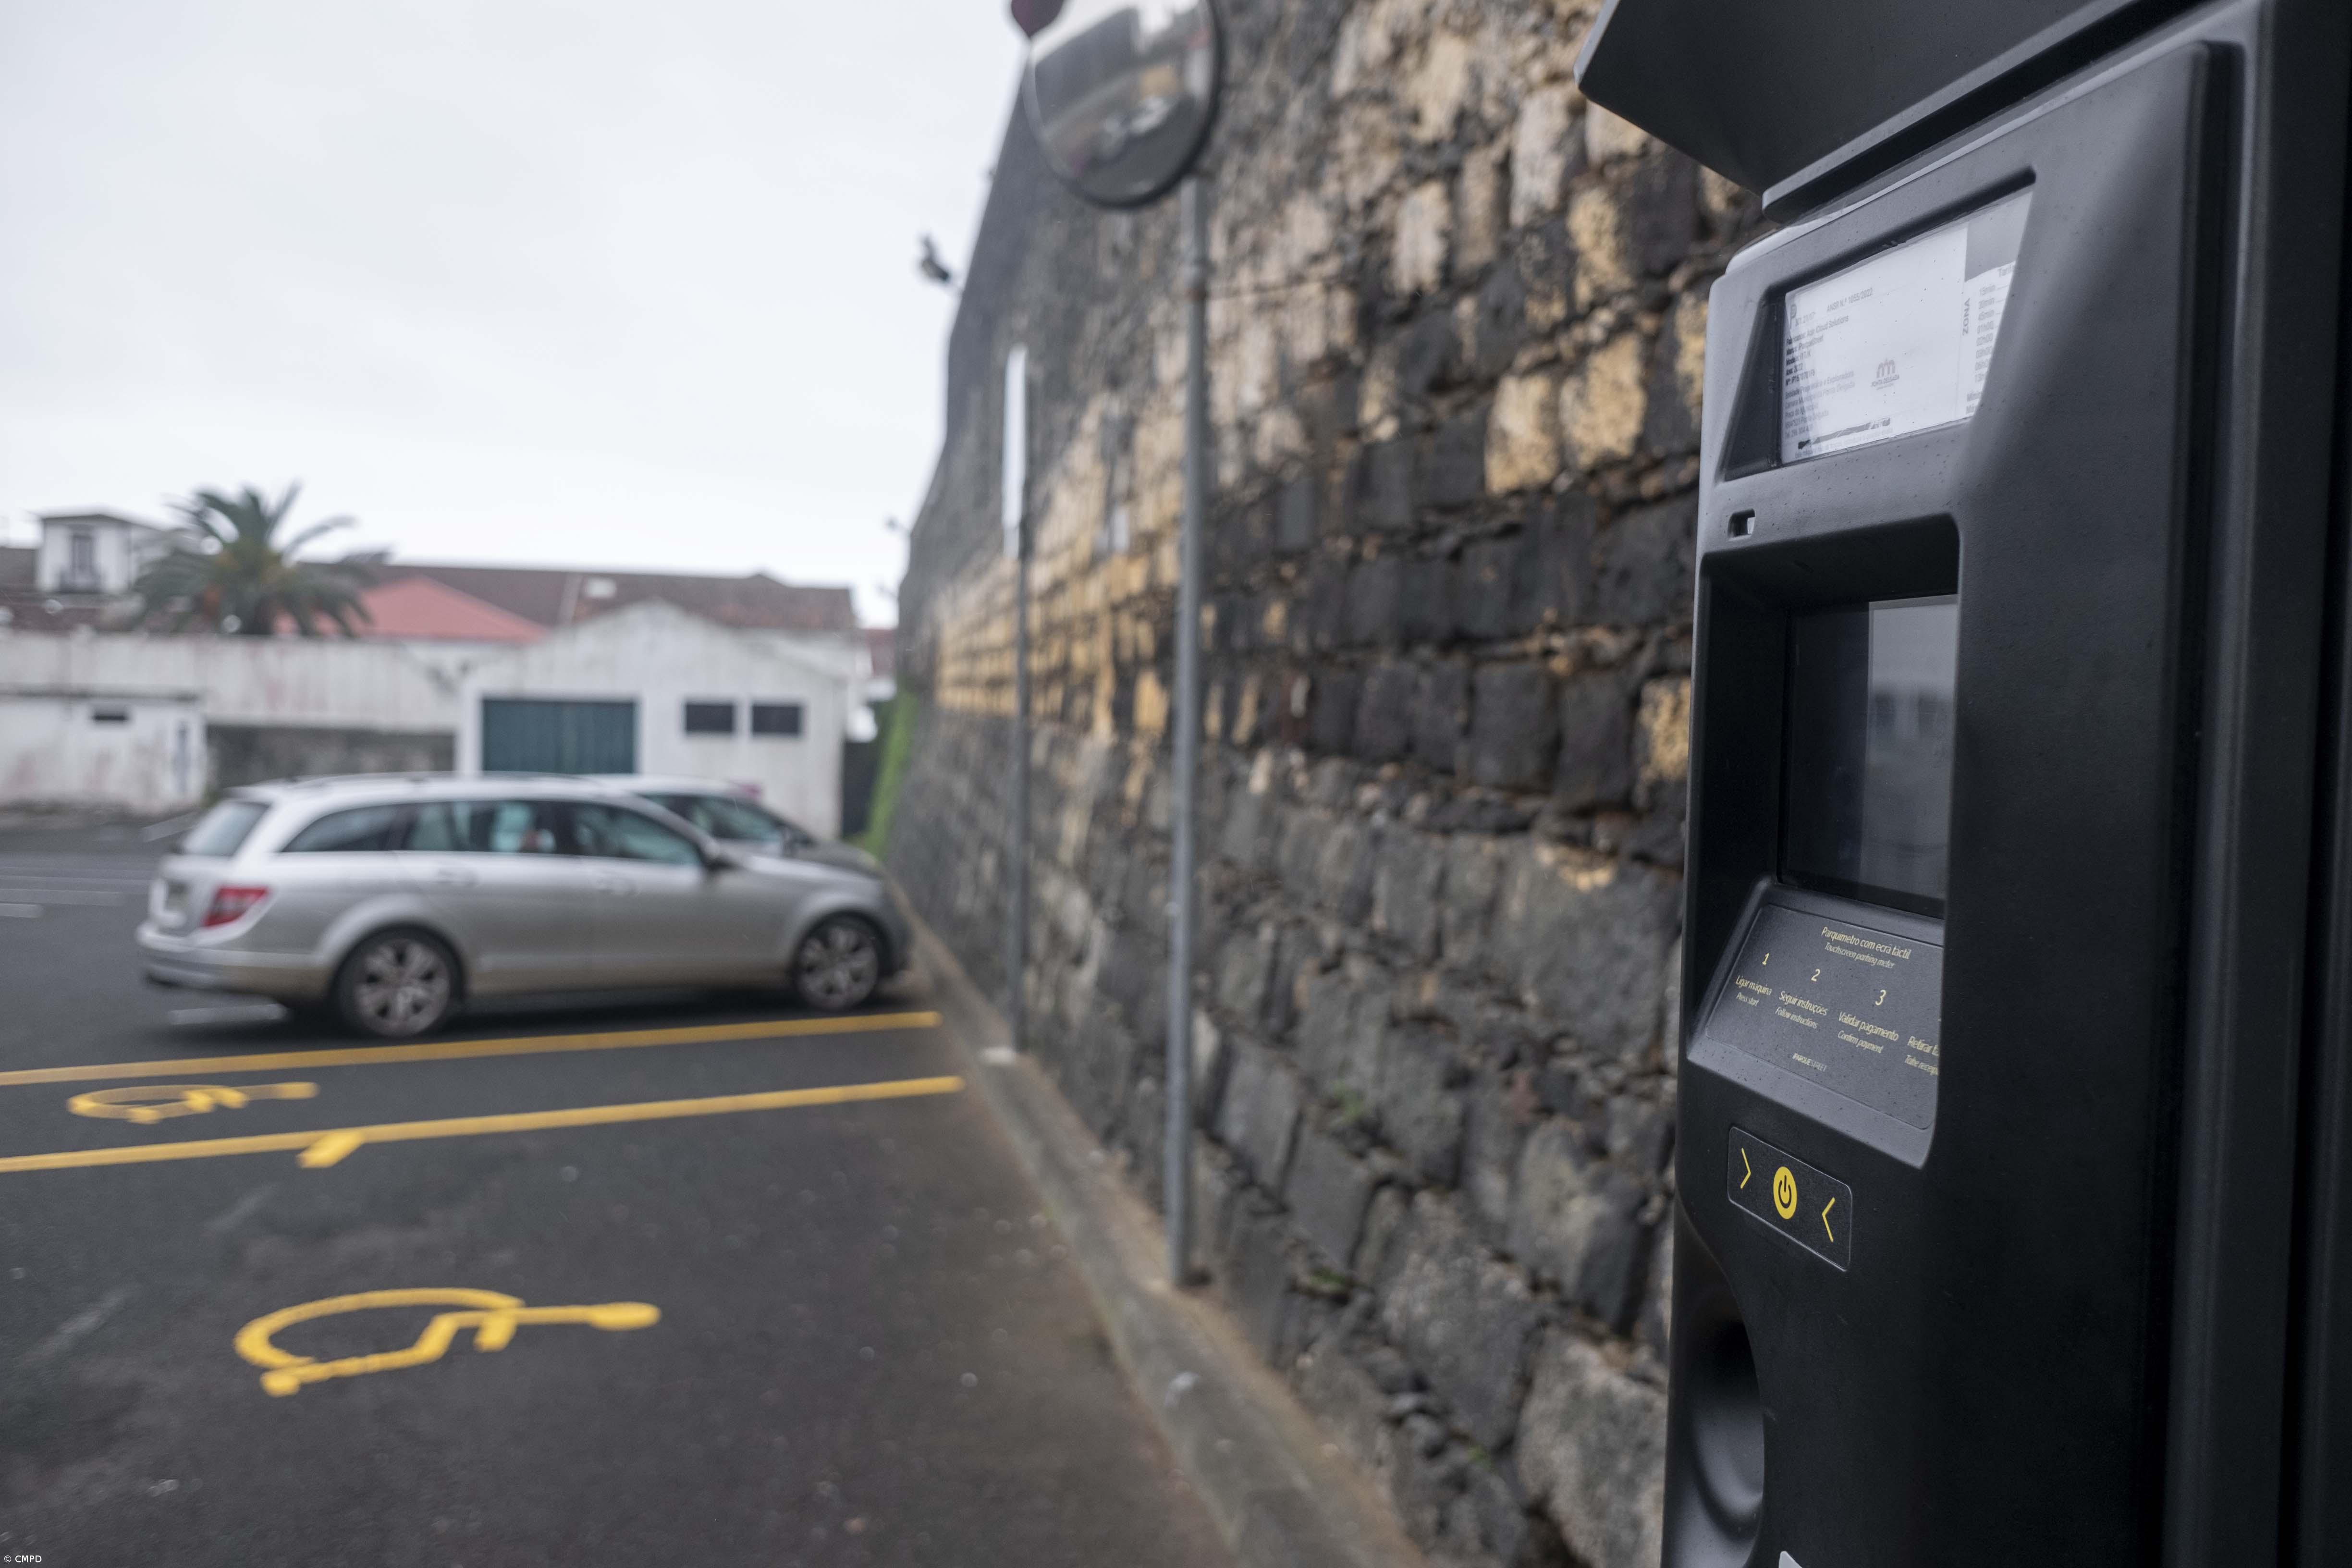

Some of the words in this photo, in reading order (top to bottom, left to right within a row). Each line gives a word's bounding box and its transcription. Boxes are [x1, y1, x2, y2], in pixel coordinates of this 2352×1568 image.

[1860, 939, 1876, 950] com
[1762, 953, 1770, 965] 1
[1825, 942, 1857, 960] Touchscreen
[1855, 953, 1878, 966] parking
[1877, 959, 1896, 969] meter
[1736, 975, 1750, 988] Ligar
[1811, 968, 1821, 982] 2
[1779, 991, 1799, 1005] Seguir
[1875, 989, 1887, 1006] 3
[1775, 1006, 1791, 1019] Follow
[1790, 1012, 1818, 1029] instructions
[1838, 1011, 1862, 1028] Validar
[1858, 1021, 1899, 1041] pagamento
[1838, 1030, 1859, 1045] Confirm
[1856, 1039, 1885, 1054] payment
[1907, 1036, 1934, 1054] Retirar
[1904, 1054, 1920, 1067] Take
